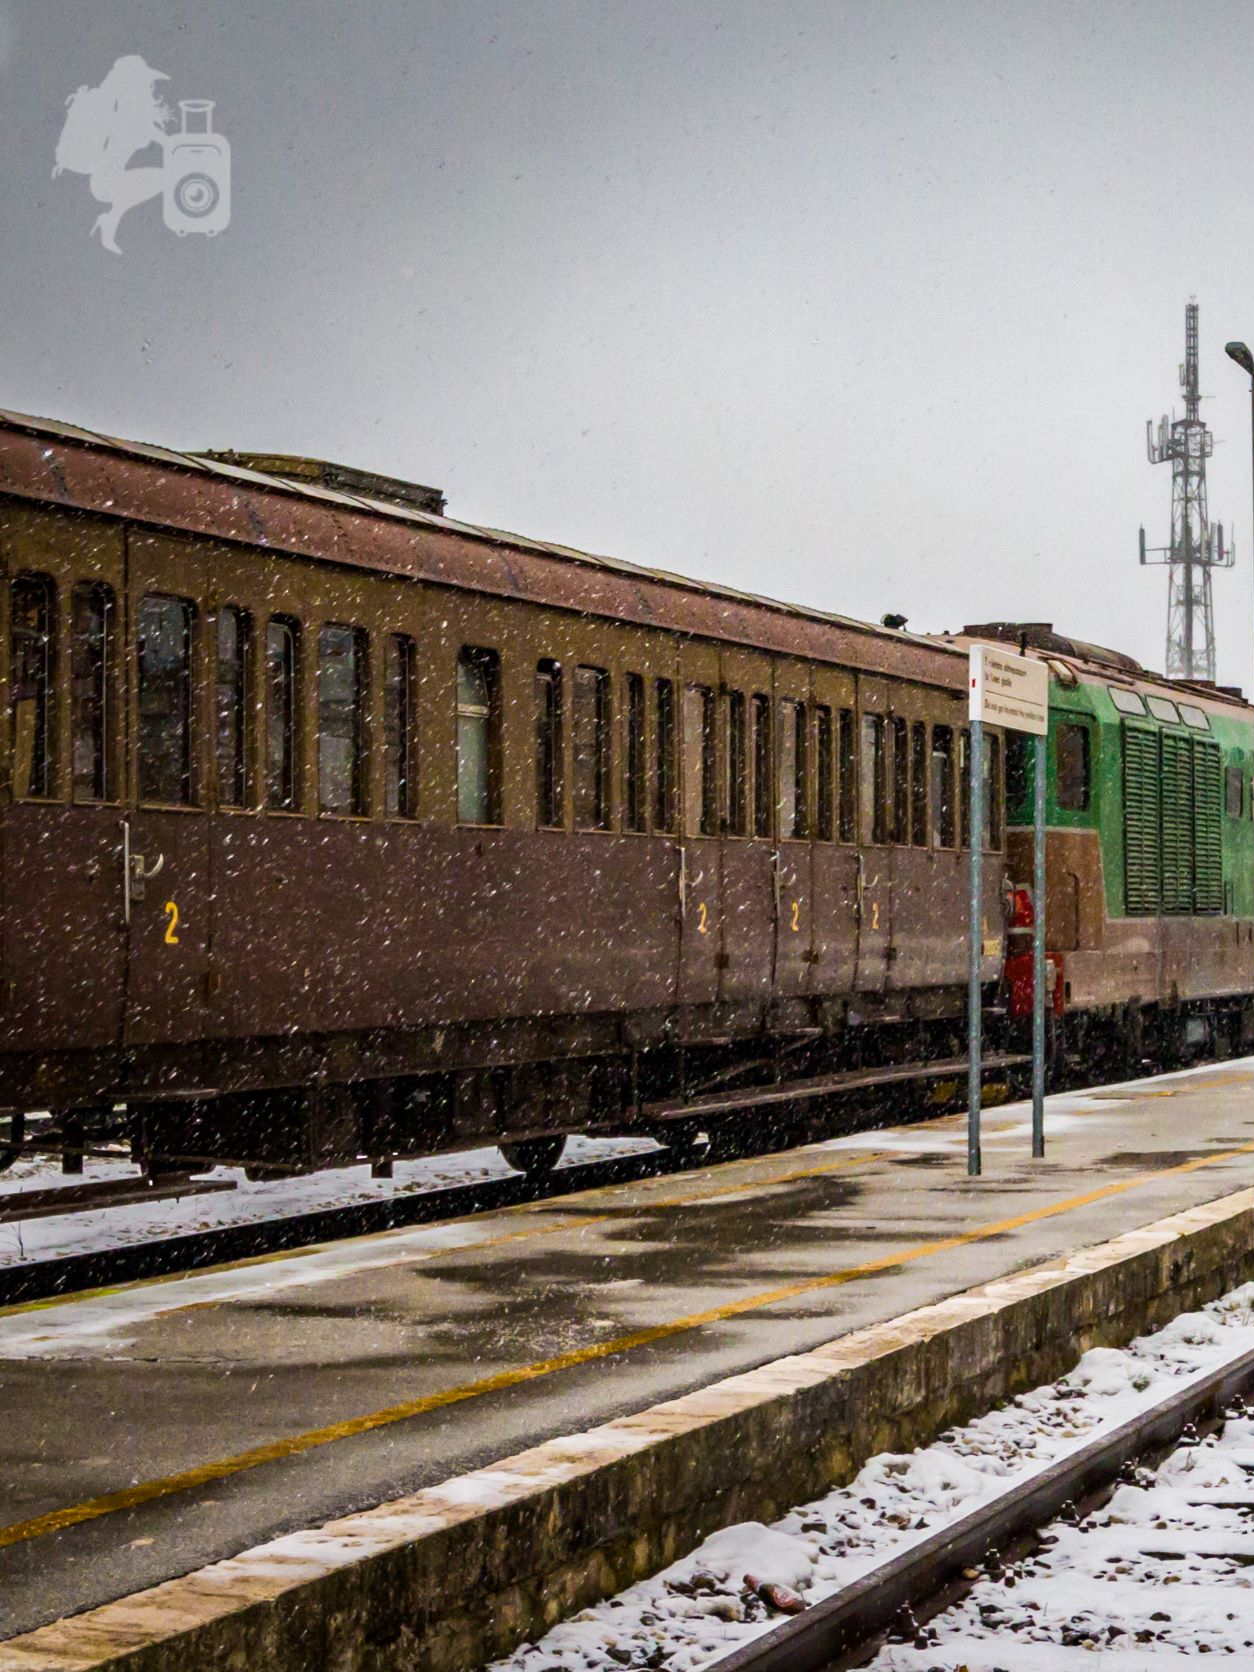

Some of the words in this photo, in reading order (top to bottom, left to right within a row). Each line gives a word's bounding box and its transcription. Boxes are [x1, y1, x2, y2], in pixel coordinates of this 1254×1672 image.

[165, 901, 178, 944] 2
[697, 902, 707, 934] 2
[791, 901, 799, 932] 2
